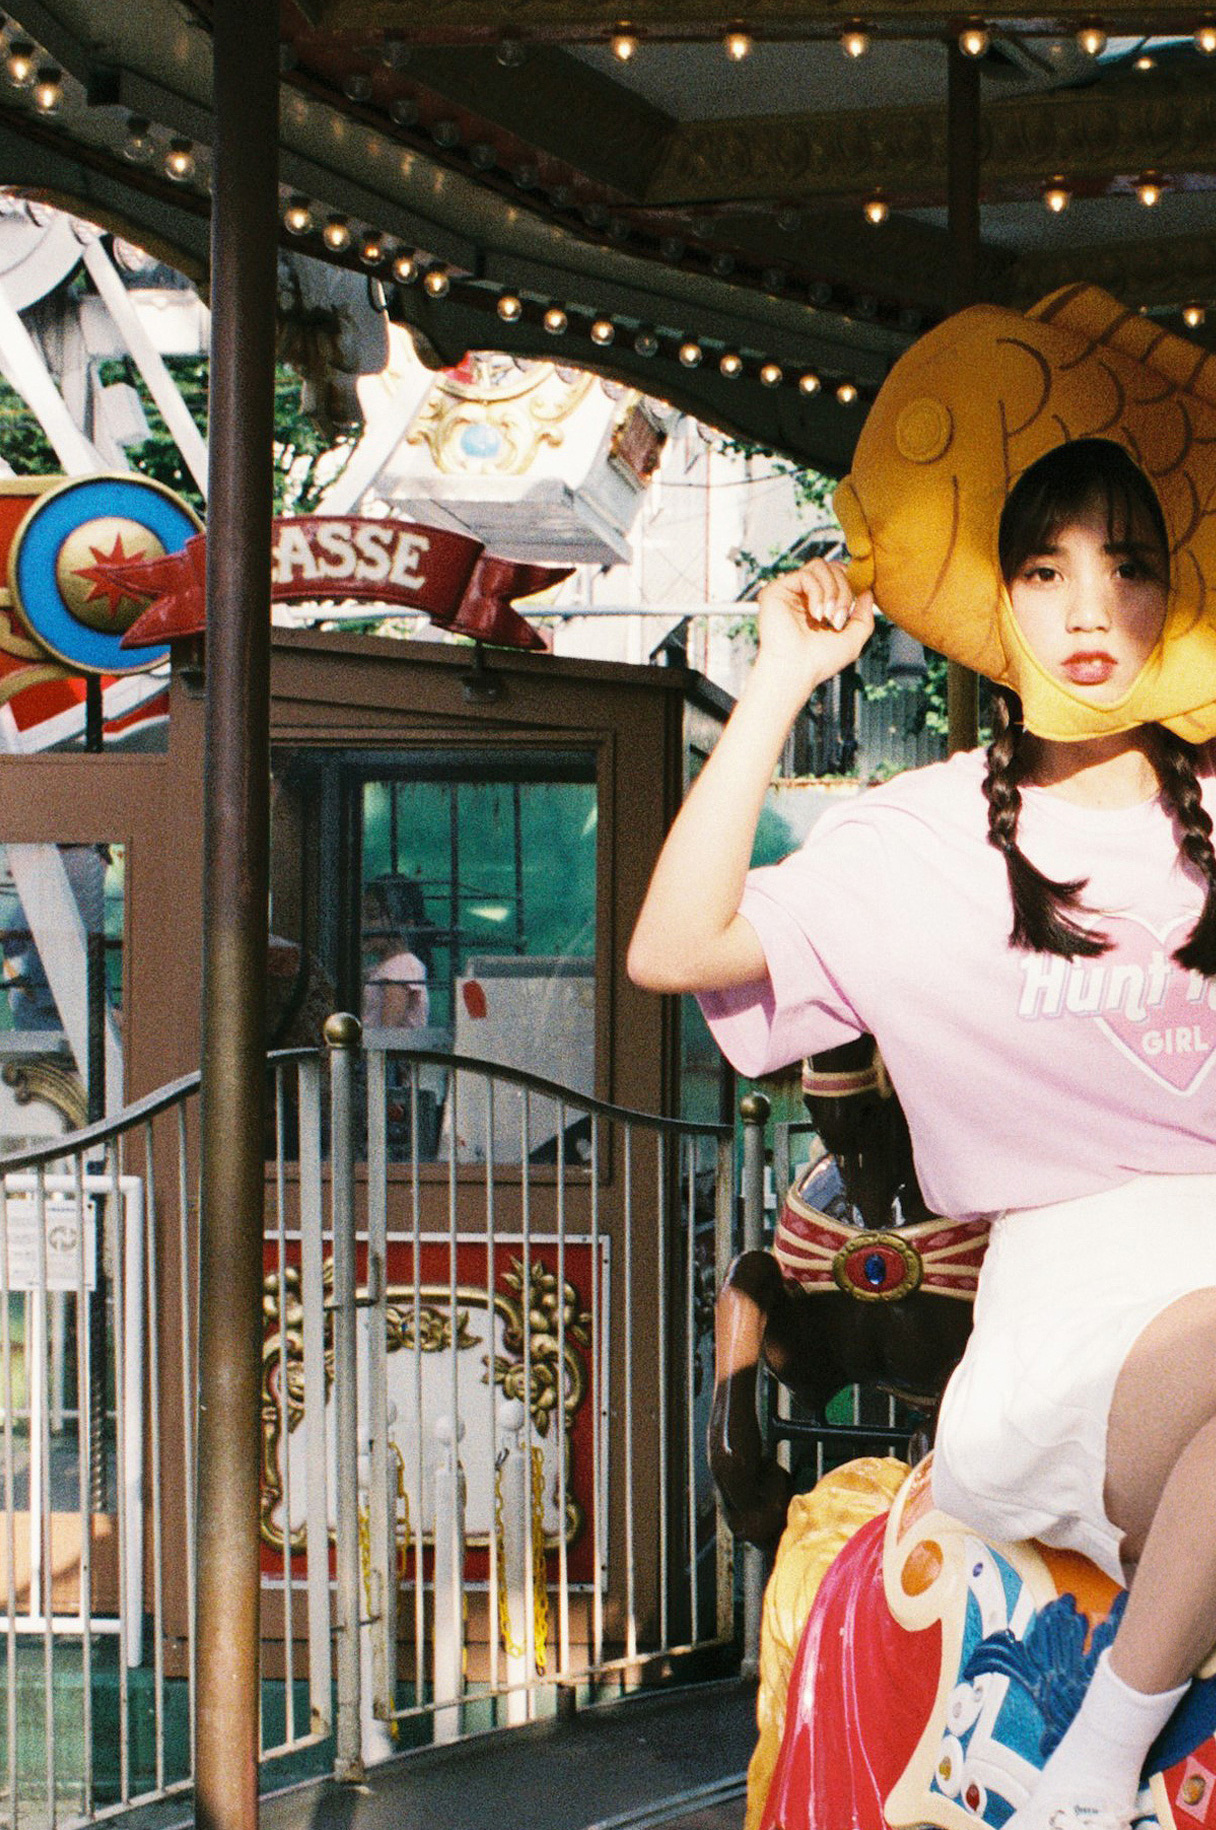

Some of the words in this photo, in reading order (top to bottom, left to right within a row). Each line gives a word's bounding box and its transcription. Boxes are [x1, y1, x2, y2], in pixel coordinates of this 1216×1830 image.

[272, 522, 430, 590] ASSE
[1017, 950, 1172, 1023] Hunt
[1142, 1026, 1210, 1056] GIRL
